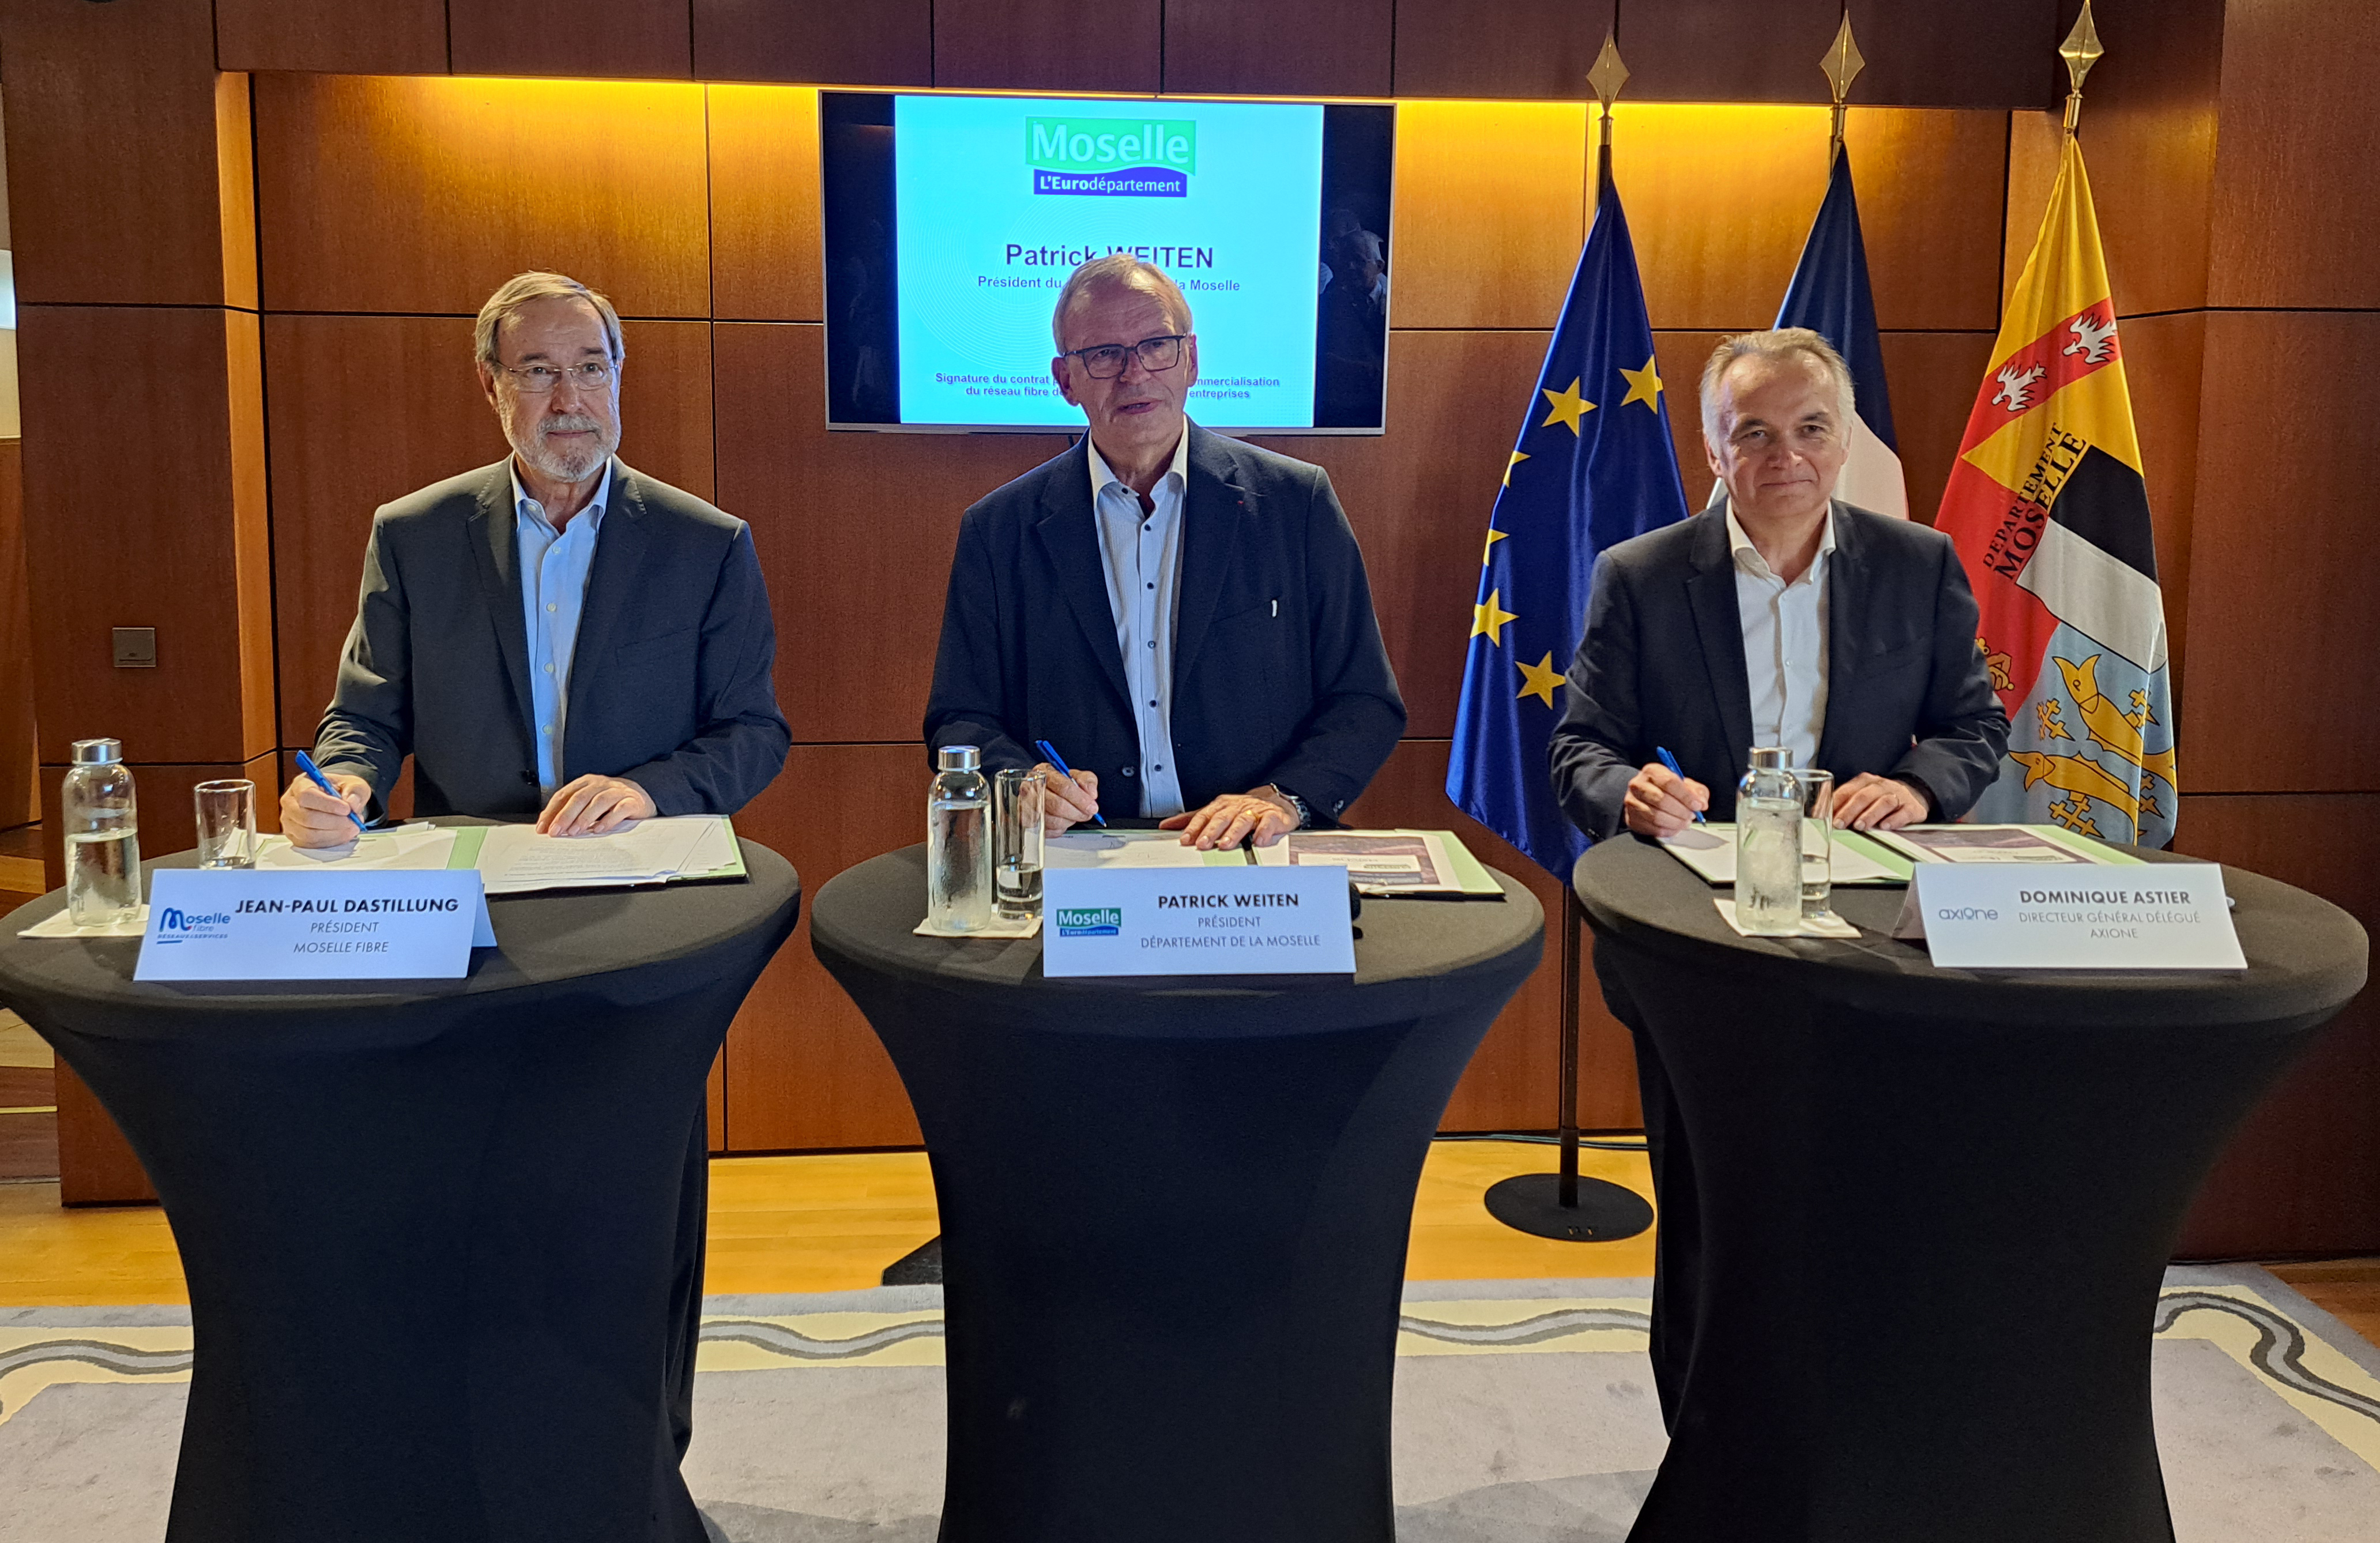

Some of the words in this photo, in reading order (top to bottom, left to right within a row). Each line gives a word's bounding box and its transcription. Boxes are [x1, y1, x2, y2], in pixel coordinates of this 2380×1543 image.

[1032, 123, 1189, 164] Moselle
[1006, 244, 1097, 266] Patrick
[978, 276, 1041, 287] Président
[1045, 277, 1061, 287] du
[1190, 280, 1240, 291] Moselle
[936, 372, 989, 385] Signature
[992, 374, 1006, 383] du
[1010, 375, 1049, 384] contrat
[966, 386, 980, 395] du
[984, 386, 1020, 396] réseau
[1024, 386, 1048, 396] fibre
[1189, 388, 1250, 399] entreprises
[1983, 423, 2062, 567] DEPARTEMENT
[1993, 432, 2087, 580] MOSELLE
[1158, 895, 1229, 908] PATRICK
[1235, 894, 1298, 907] WEITEN
[2020, 891, 2129, 905] DOMINIQUE
[2133, 891, 2190, 904] ASTIER
[235, 899, 338, 913] JEAN-PAUL
[344, 898, 460, 913] DASTILLUNG
[1059, 910, 1119, 925] Moselle
[1939, 907, 1998, 920] axione
[2020, 911, 2084, 923] DIRECTEUR
[2087, 910, 2144, 923] GÉNÉRAL
[2146, 910, 2201, 923] DÉLÉGUÉ
[310, 921, 379, 933] PRÉSIDENT
[1198, 915, 1261, 928] PRÉSIDENT
[2090, 928, 2138, 939] AXIONE
[293, 942, 351, 953] MOSELLE
[355, 942, 389, 953] FIBRE
[1141, 934, 1226, 948] DÉPARTEMENT
[1231, 936, 1247, 947] DE
[1249, 936, 1264, 947] LA
[1267, 935, 1320, 947] MOSELLE
